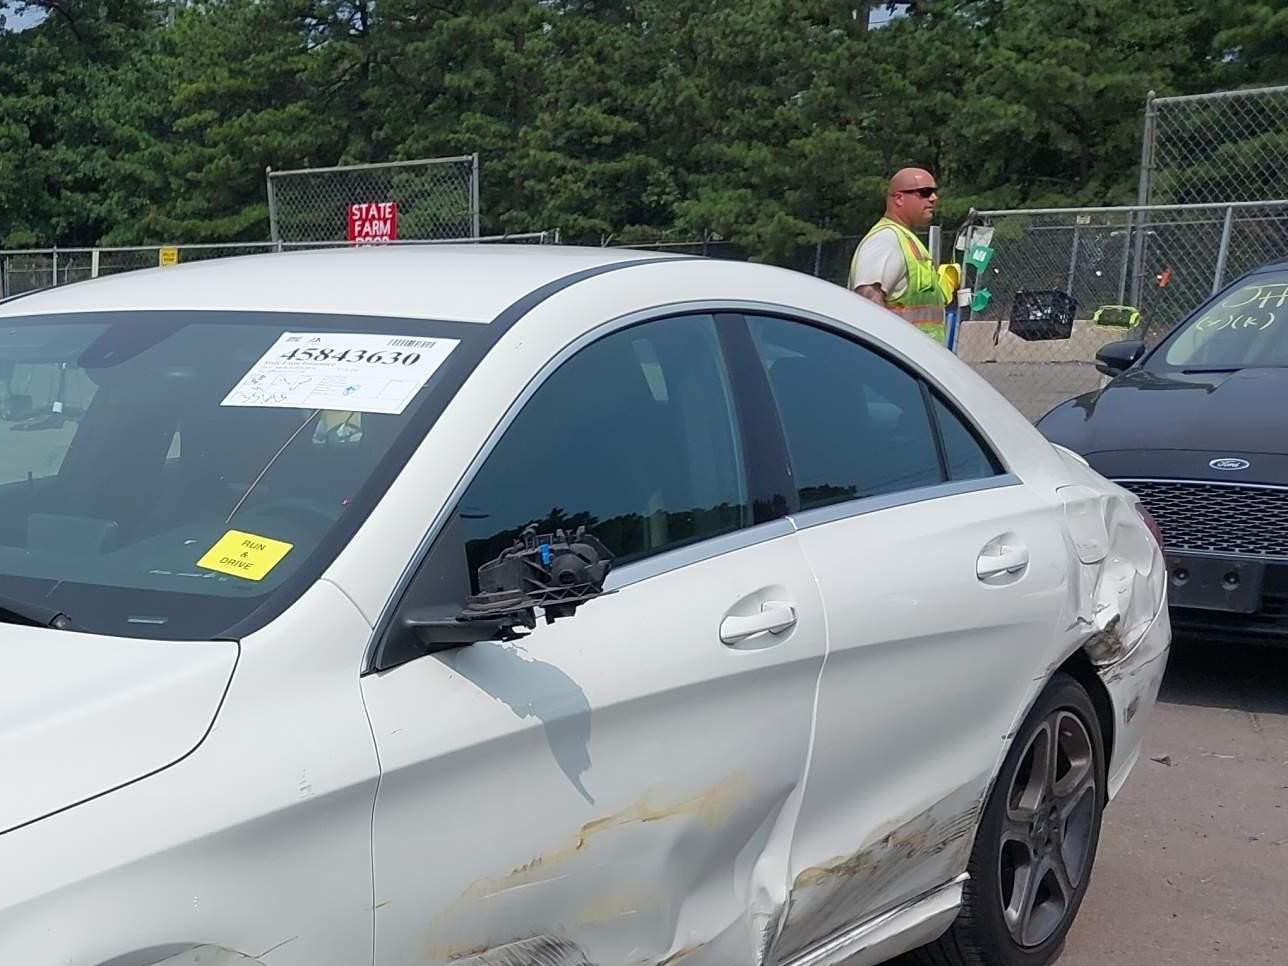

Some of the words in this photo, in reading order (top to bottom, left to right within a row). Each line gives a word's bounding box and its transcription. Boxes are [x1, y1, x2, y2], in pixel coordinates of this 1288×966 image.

[352, 202, 393, 220] STATE
[354, 220, 391, 236] FARM
[280, 347, 421, 367] 45843630
[241, 540, 266, 551] RUN
[219, 557, 254, 570] DRIVE
